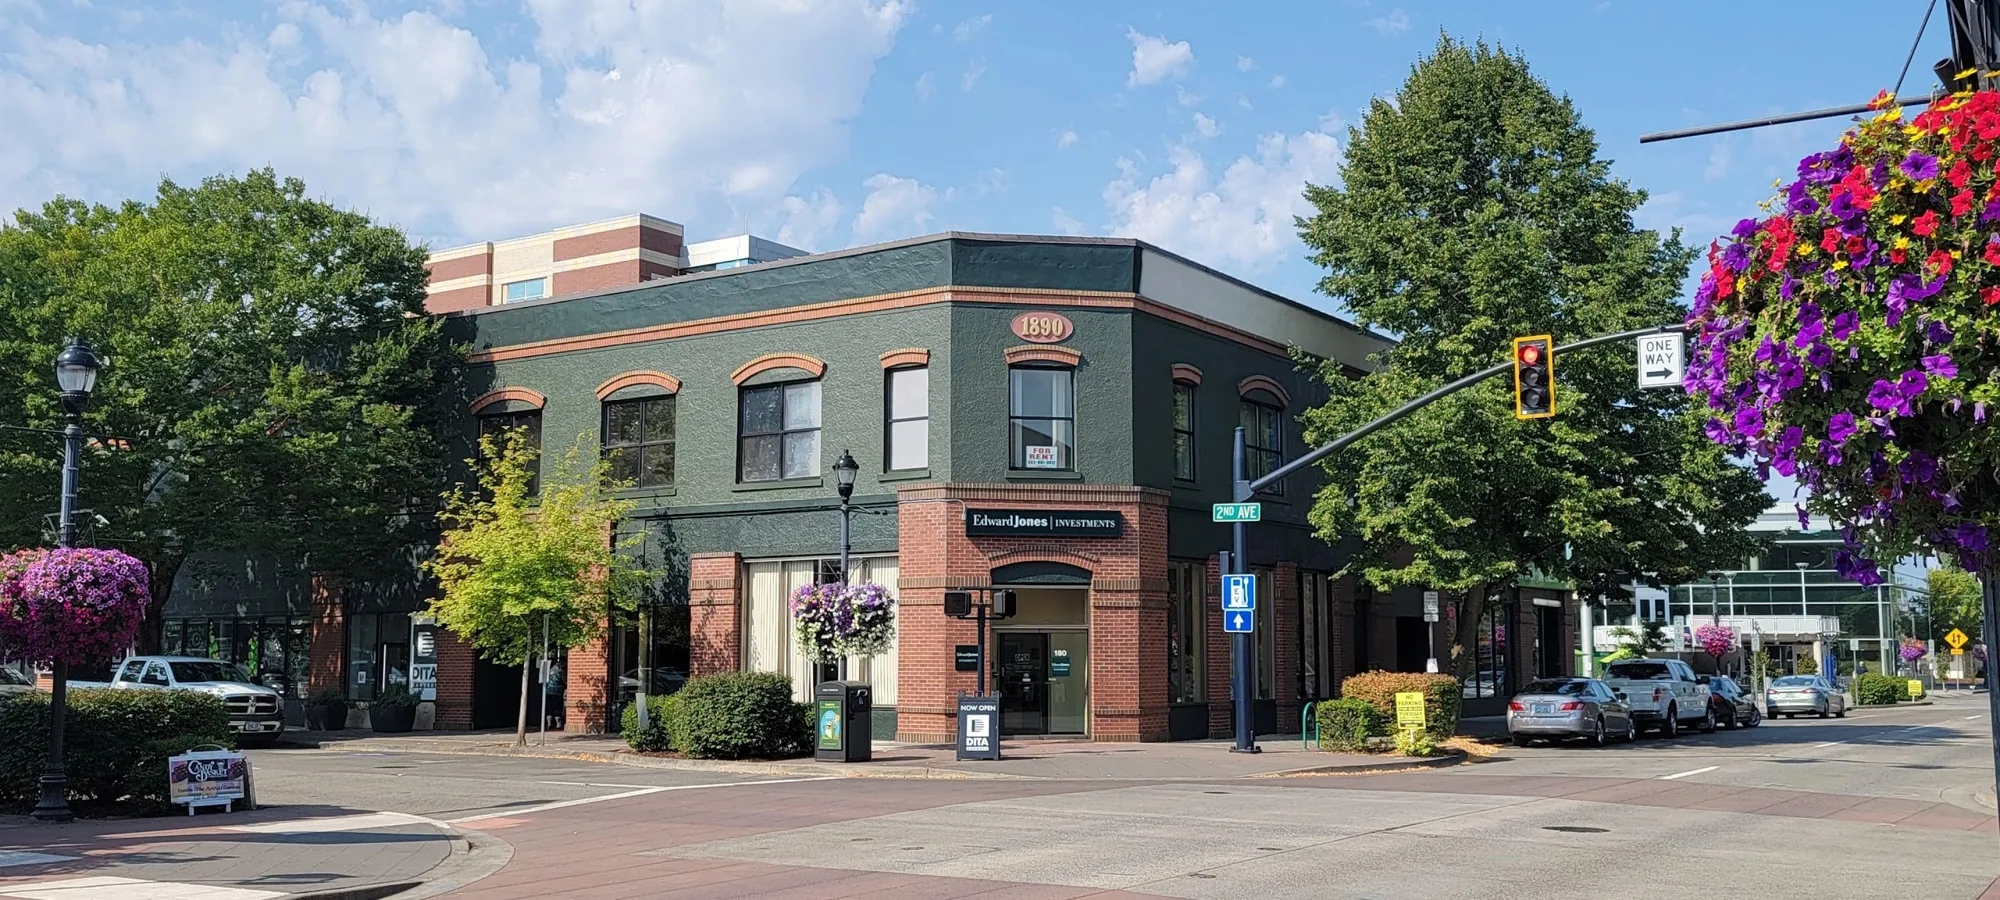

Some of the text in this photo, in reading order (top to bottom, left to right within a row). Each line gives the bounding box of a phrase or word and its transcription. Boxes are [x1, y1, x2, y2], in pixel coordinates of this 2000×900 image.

[1021, 317, 1064, 337] 1890
[1646, 340, 1673, 352] ONE
[1645, 352, 1674, 365] WAY
[1216, 505, 1257, 520] 2ND AVE
[1055, 519, 1116, 528] INVESTMENTS
[412, 666, 437, 680] DITA
[965, 737, 989, 746] DITA
